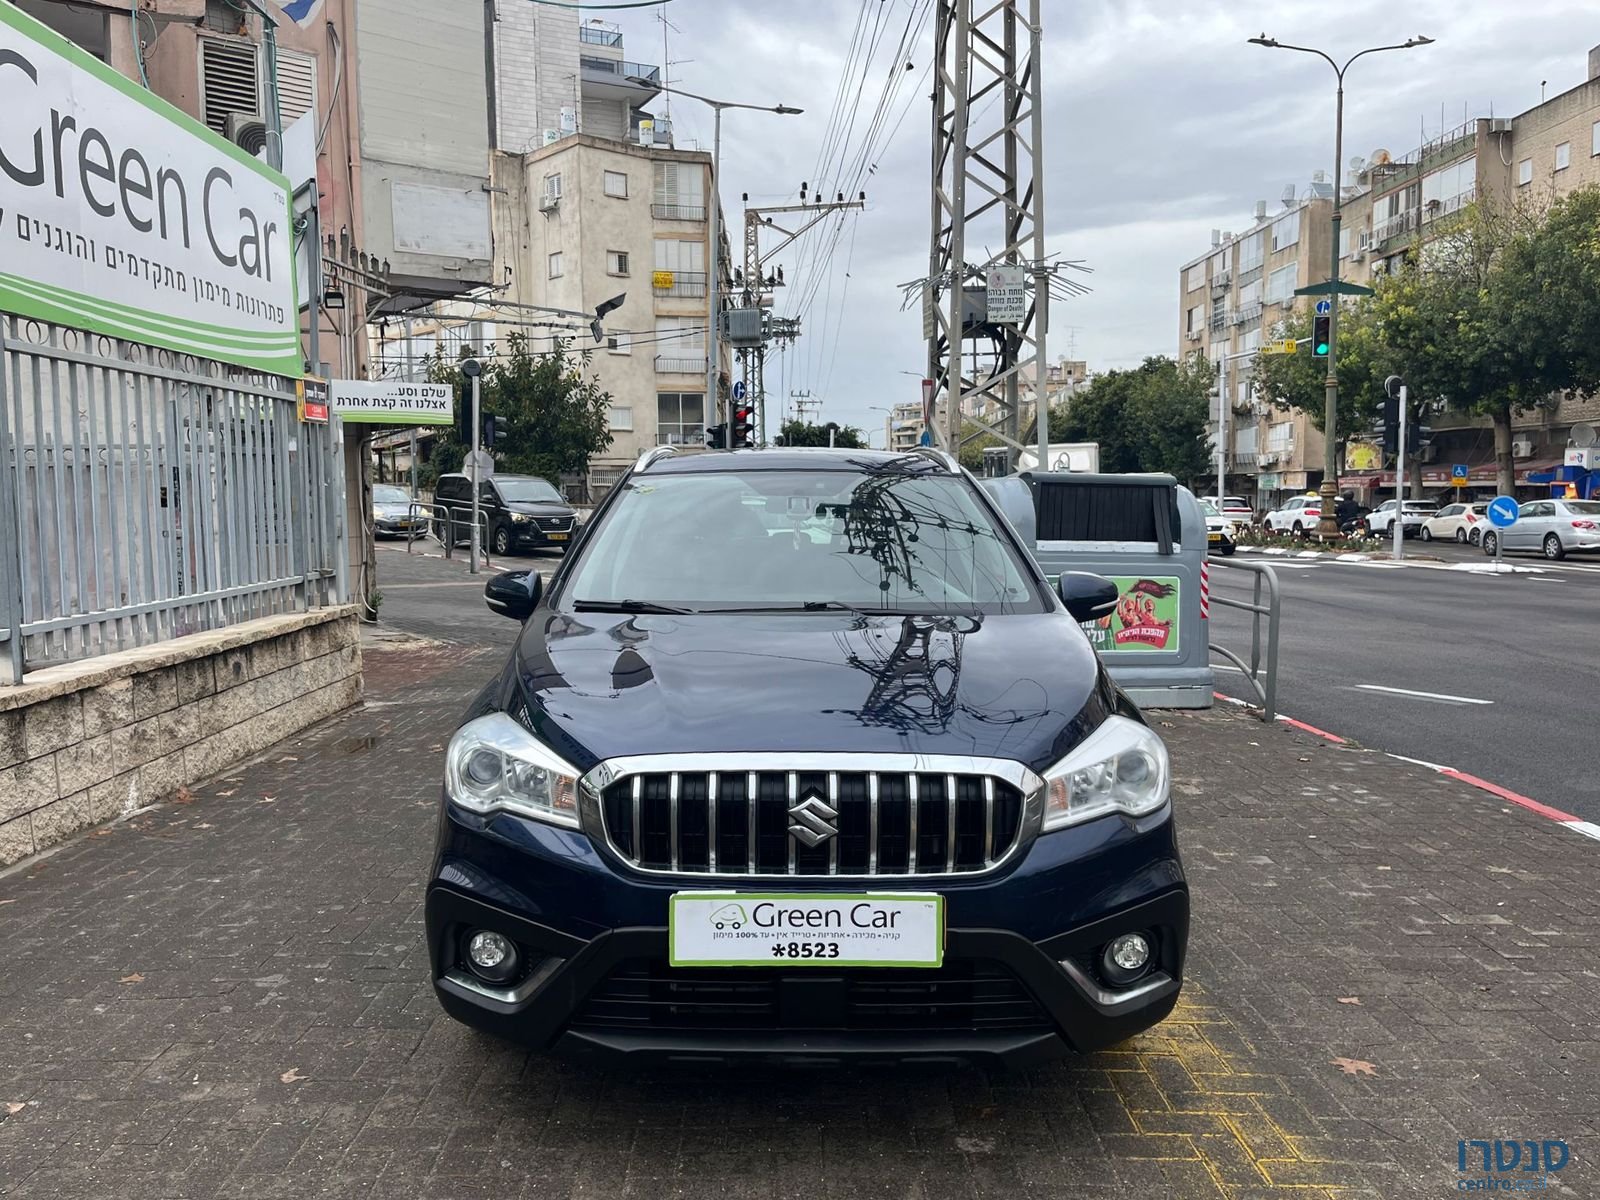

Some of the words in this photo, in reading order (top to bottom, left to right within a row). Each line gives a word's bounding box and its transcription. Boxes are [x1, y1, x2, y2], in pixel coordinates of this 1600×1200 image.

[0, 48, 190, 249] Green
[203, 166, 277, 282] Car
[16, 213, 96, 262] והוגנים
[105, 245, 187, 292] מתקדמים
[193, 276, 231, 307] מימון
[236, 292, 284, 324] פתרונות
[387, 387, 418, 397] וסע...
[422, 386, 446, 397] שלם
[337, 396, 368, 407] אחרת
[372, 398, 396, 410] קצת
[400, 398, 412, 408] זה
[416, 398, 446, 409] אצלנו
[753, 902, 841, 928] Green
[850, 902, 901, 928] Car
[713, 932, 733, 940] מימון
[736, 931, 758, 939] 100%
[882, 932, 901, 940] קניה
